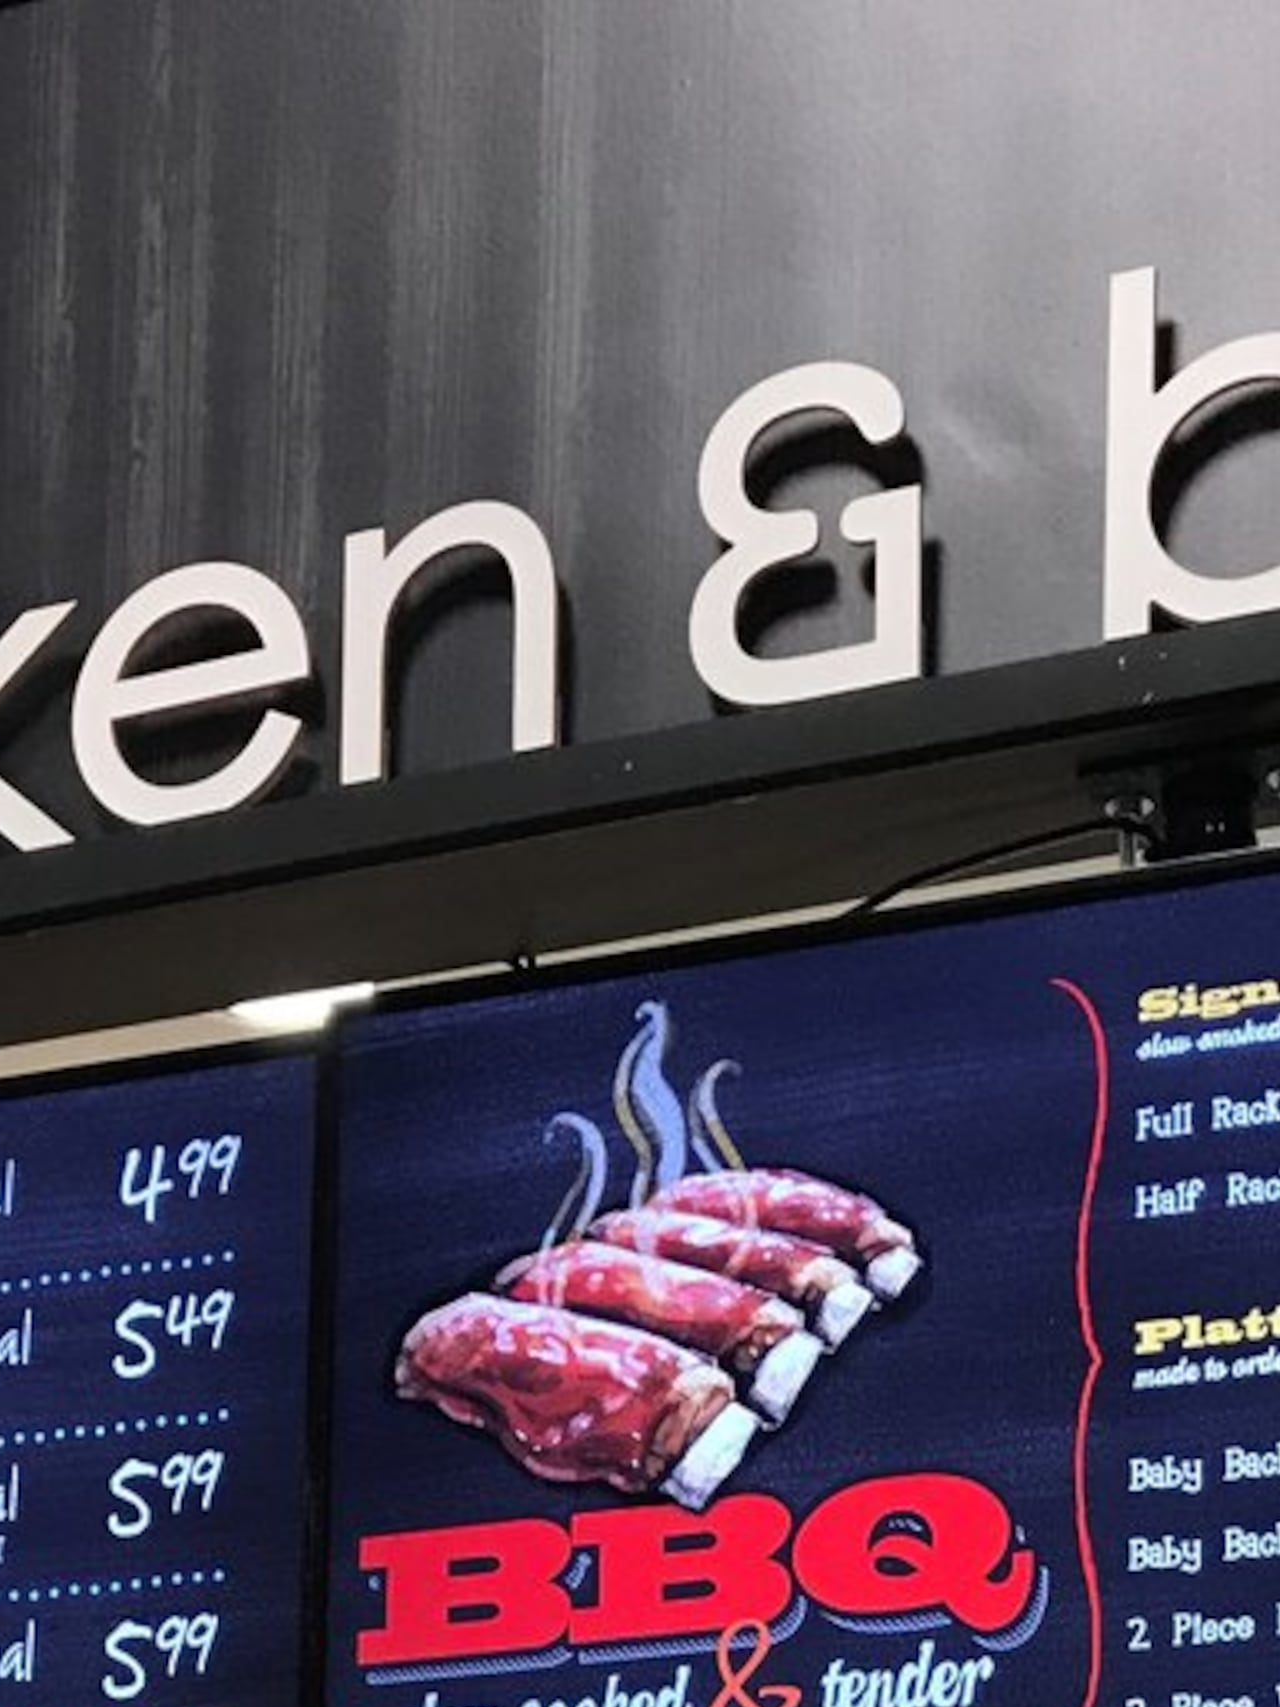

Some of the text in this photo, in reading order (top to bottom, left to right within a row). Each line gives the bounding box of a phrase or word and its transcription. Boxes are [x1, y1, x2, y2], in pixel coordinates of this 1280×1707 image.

[689, 354, 928, 708] &
[1135, 1030, 1191, 1060] slow
[1134, 1102, 1193, 1141] Full
[1134, 1183, 1204, 1220] Half
[1132, 1359, 1197, 1390] made
[1204, 1357, 1226, 1384] to
[1129, 1455, 1203, 1494] Baby
[356, 1472, 1036, 1665] BBQ
[1129, 1535, 1203, 1574] Baby
[1129, 1619, 1152, 1652] 2
[1172, 1611, 1254, 1647] Piece
